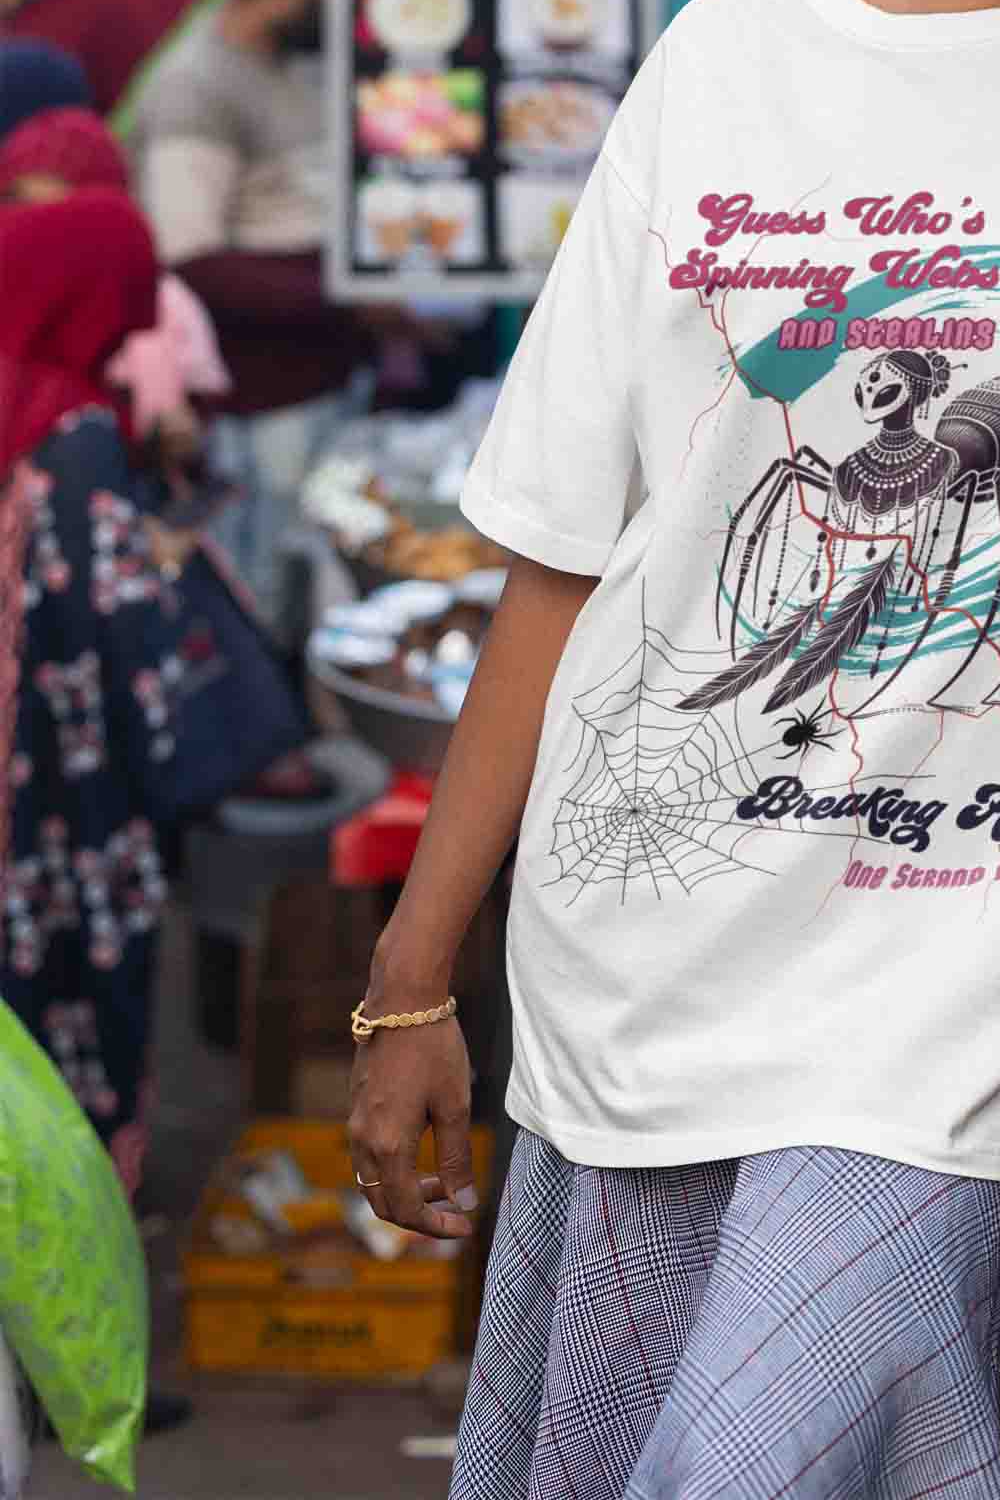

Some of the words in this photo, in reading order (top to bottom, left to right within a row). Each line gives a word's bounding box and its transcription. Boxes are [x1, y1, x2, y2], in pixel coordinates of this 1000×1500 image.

[698, 193, 826, 247] Guess
[843, 191, 985, 235] Who's
[669, 248, 855, 314] Spinning
[869, 244, 1000, 289] Webs
[736, 775, 949, 853] Breaking
